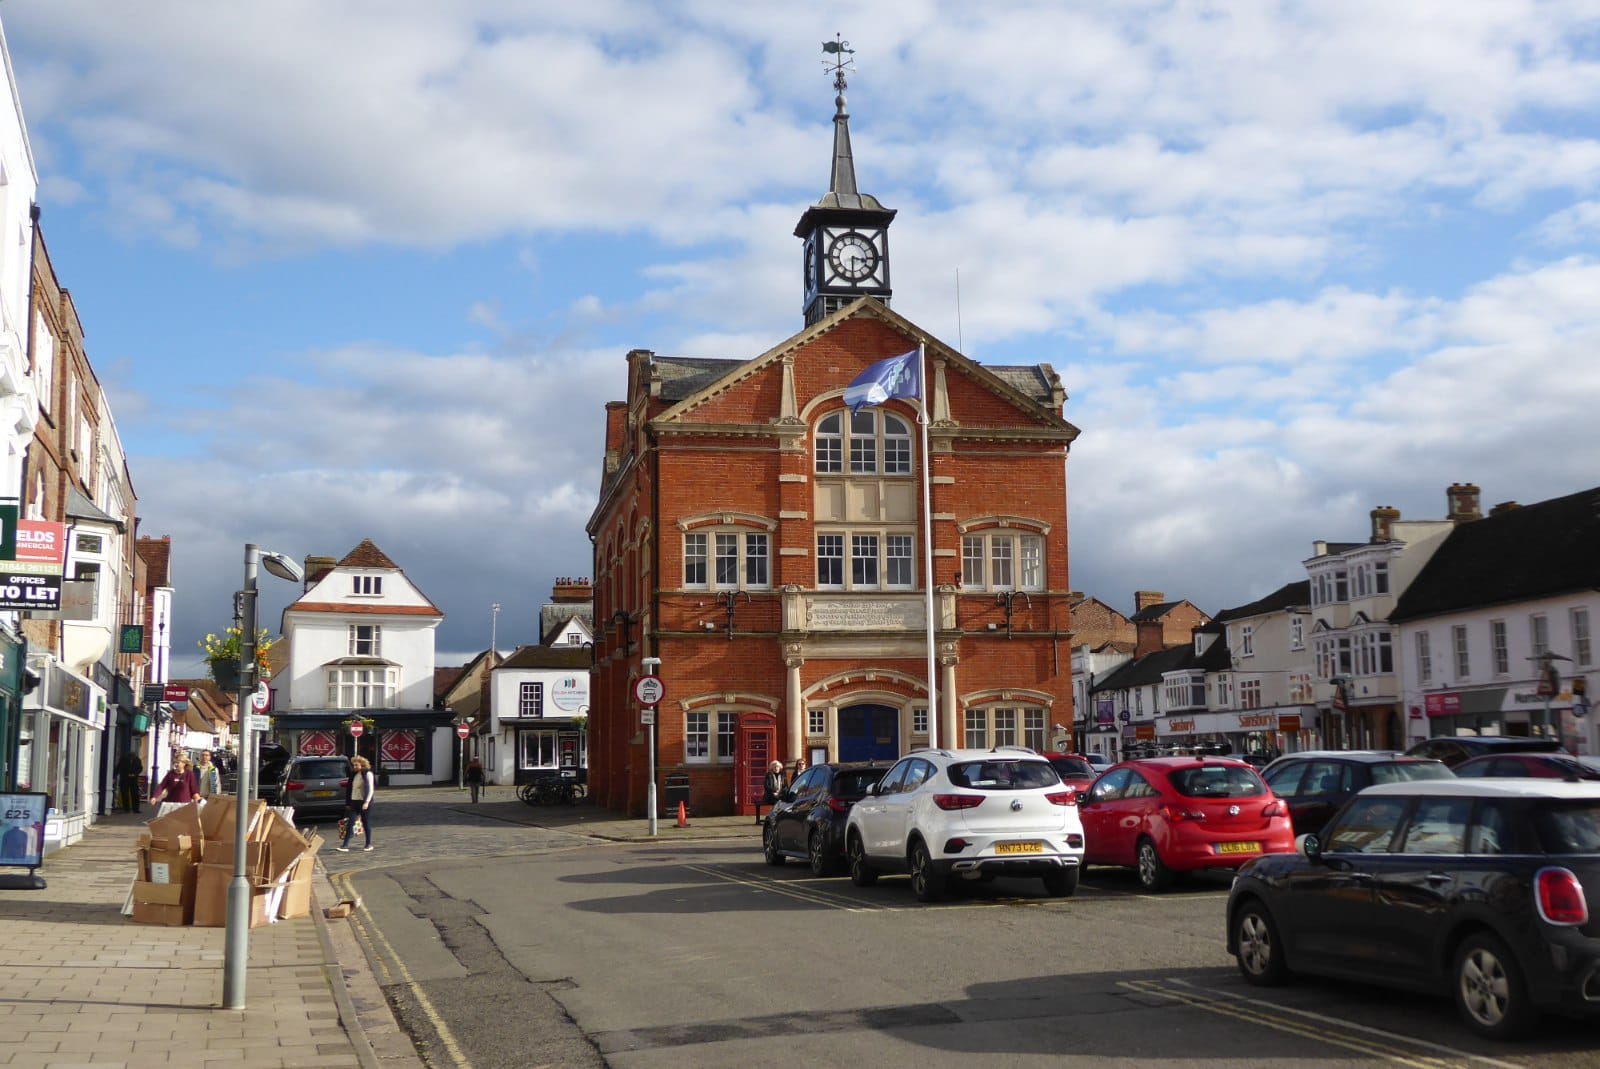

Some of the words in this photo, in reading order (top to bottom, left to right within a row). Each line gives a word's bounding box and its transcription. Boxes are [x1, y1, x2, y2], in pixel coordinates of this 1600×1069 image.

[10, 576, 46, 584] OFFICES
[0, 586, 20, 599] TO
[26, 587, 58, 600] LET
[1169, 718, 1195, 731] Sainsbury's
[1239, 715, 1276, 727] Sainsbury's
[306, 743, 329, 751] SALE
[387, 743, 410, 751] SALE
[5, 809, 31, 819] £25
[999, 843, 1021, 852] HN73
